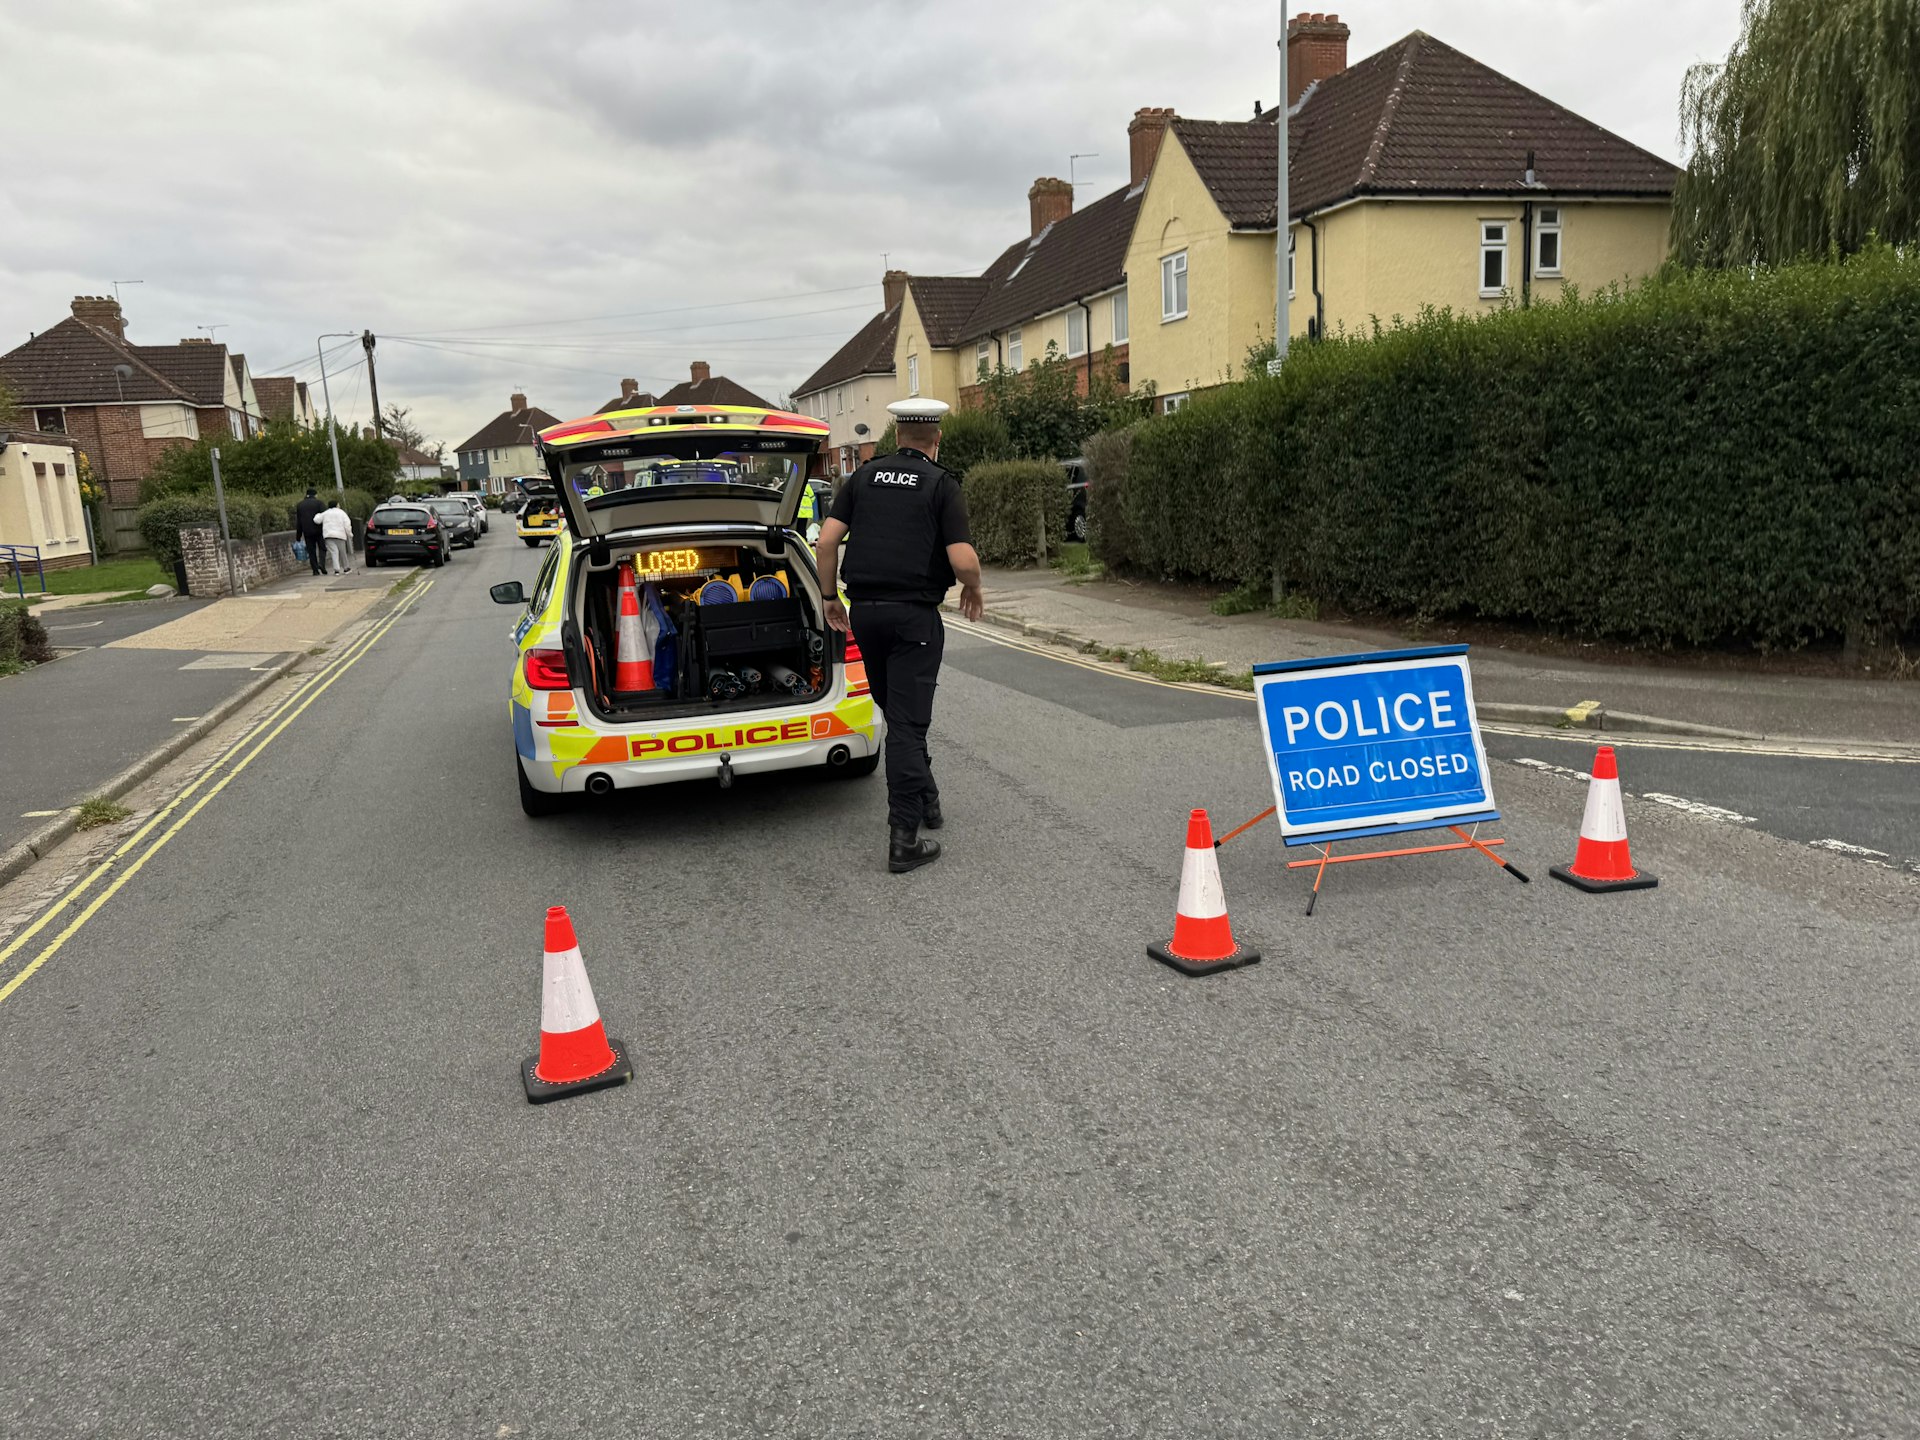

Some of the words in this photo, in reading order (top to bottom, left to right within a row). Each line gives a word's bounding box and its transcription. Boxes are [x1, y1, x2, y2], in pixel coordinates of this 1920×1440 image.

[873, 471, 919, 486] POLICE
[635, 549, 699, 574] LOSED
[1282, 690, 1457, 745] POLICE
[631, 721, 809, 757] POLICE
[1288, 765, 1360, 792] ROAD
[1368, 753, 1469, 783] CLOSED
